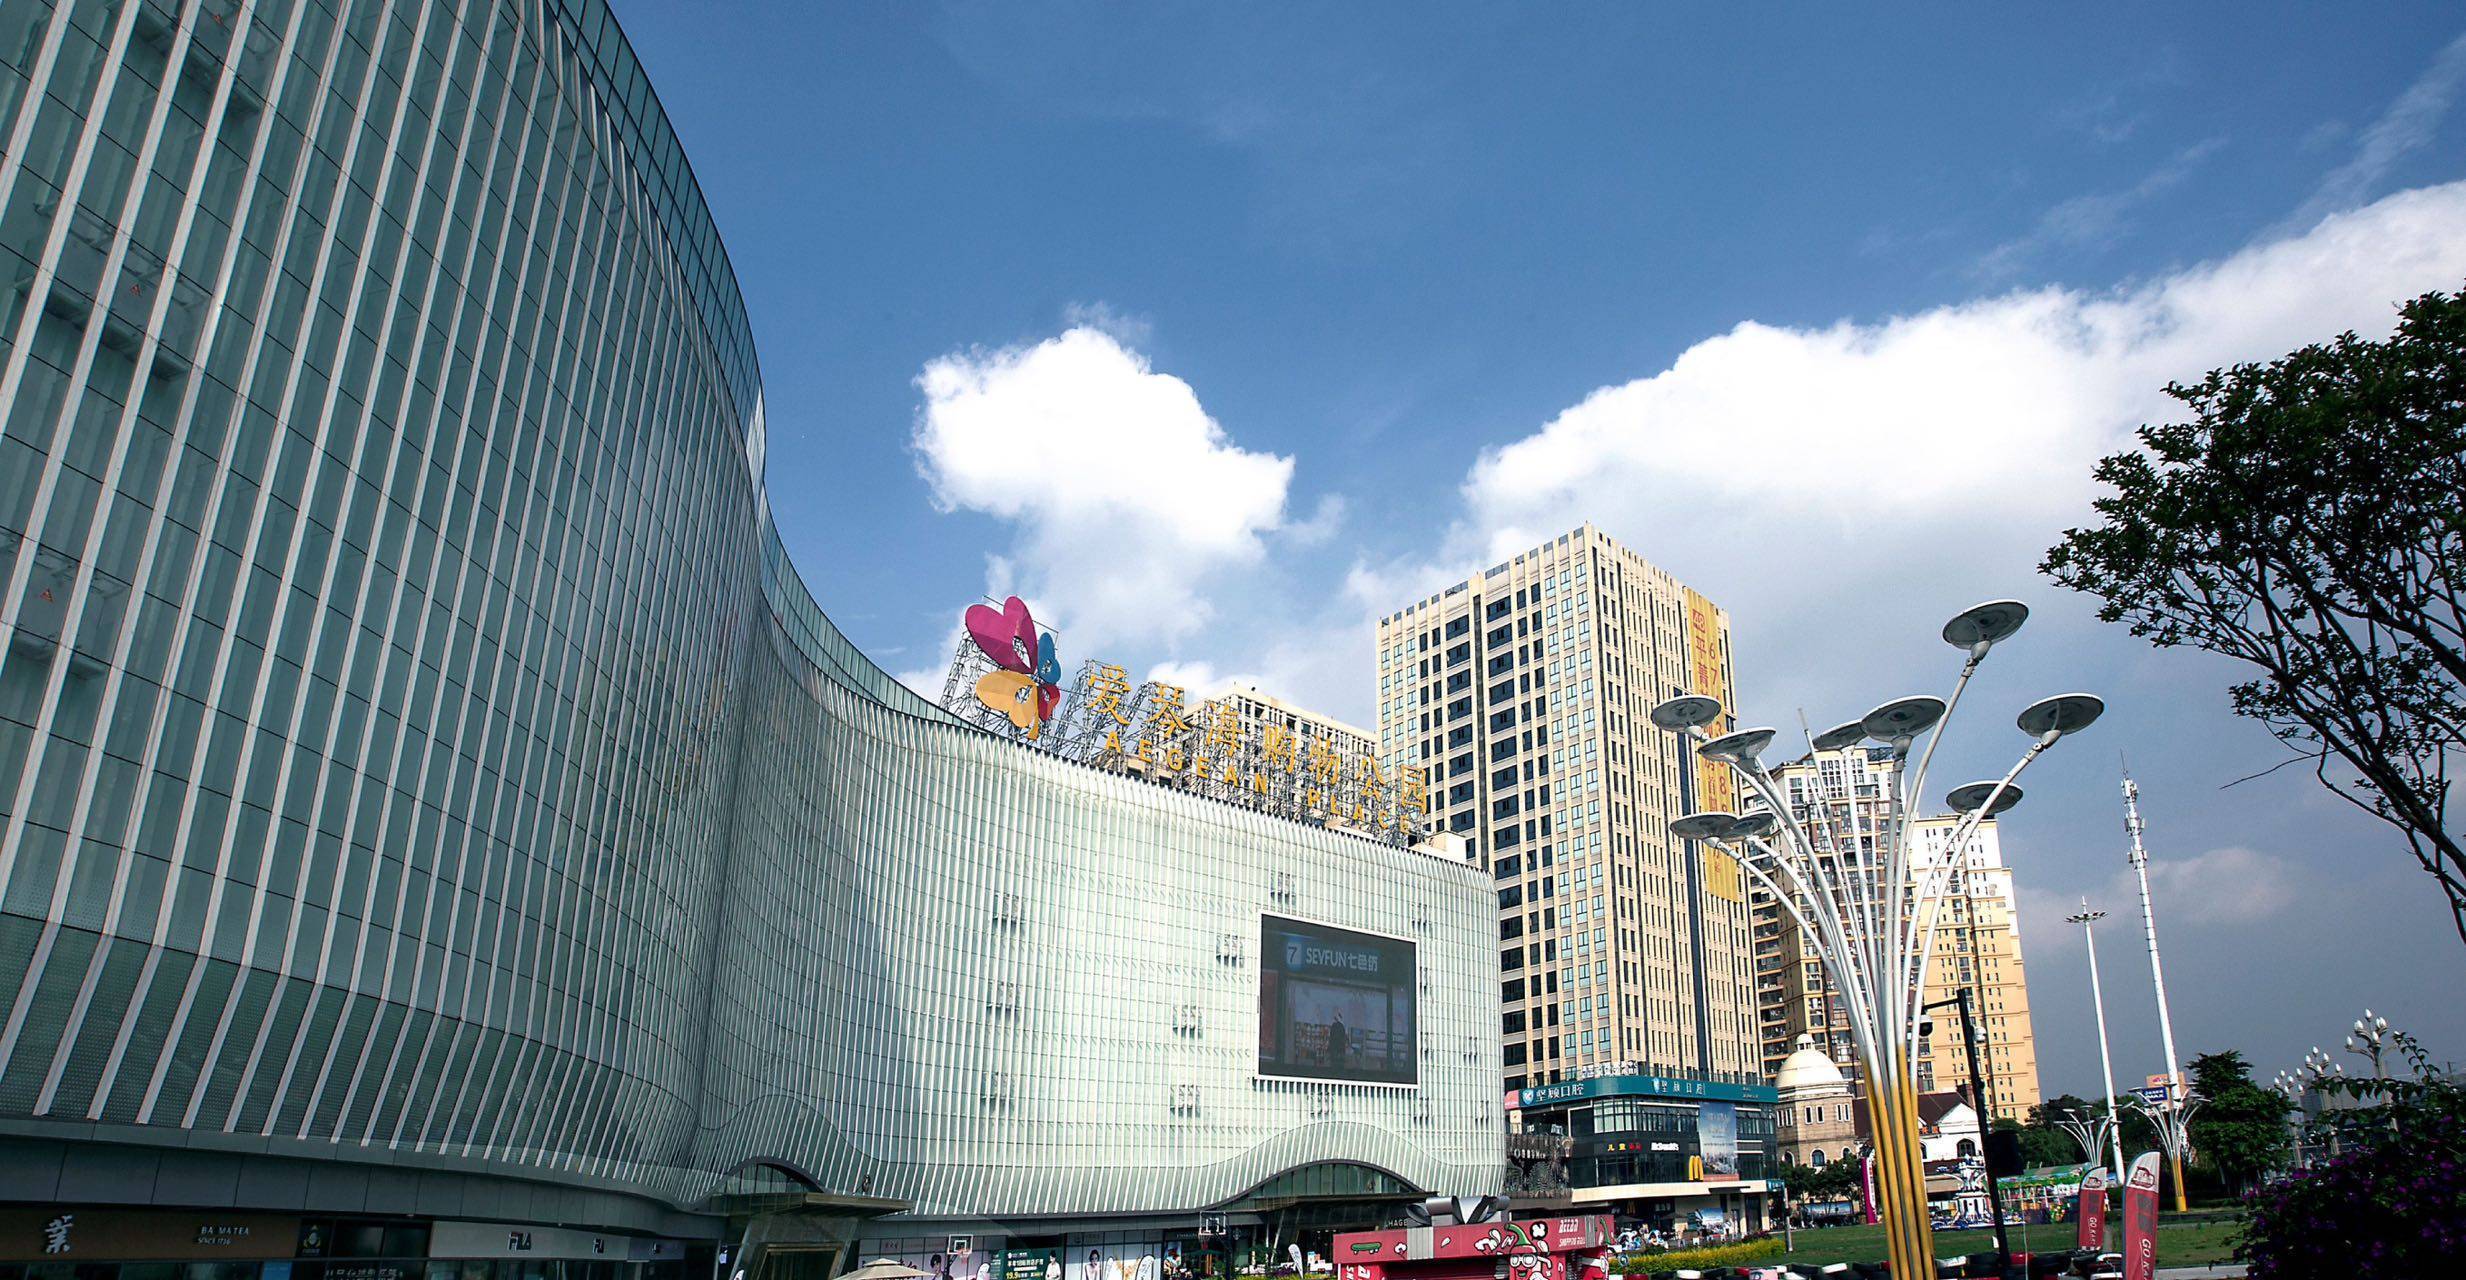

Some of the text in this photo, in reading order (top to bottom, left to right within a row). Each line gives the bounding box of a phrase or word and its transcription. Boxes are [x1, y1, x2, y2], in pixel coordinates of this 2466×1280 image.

[1086, 664, 1427, 815] 爱琴海购物公园
[1105, 730, 1409, 835] AEGEAN PLACE
[1306, 947, 1347, 968] SEVFUN
[507, 1231, 532, 1252] FILA
[2142, 1238, 2153, 1258] GO
